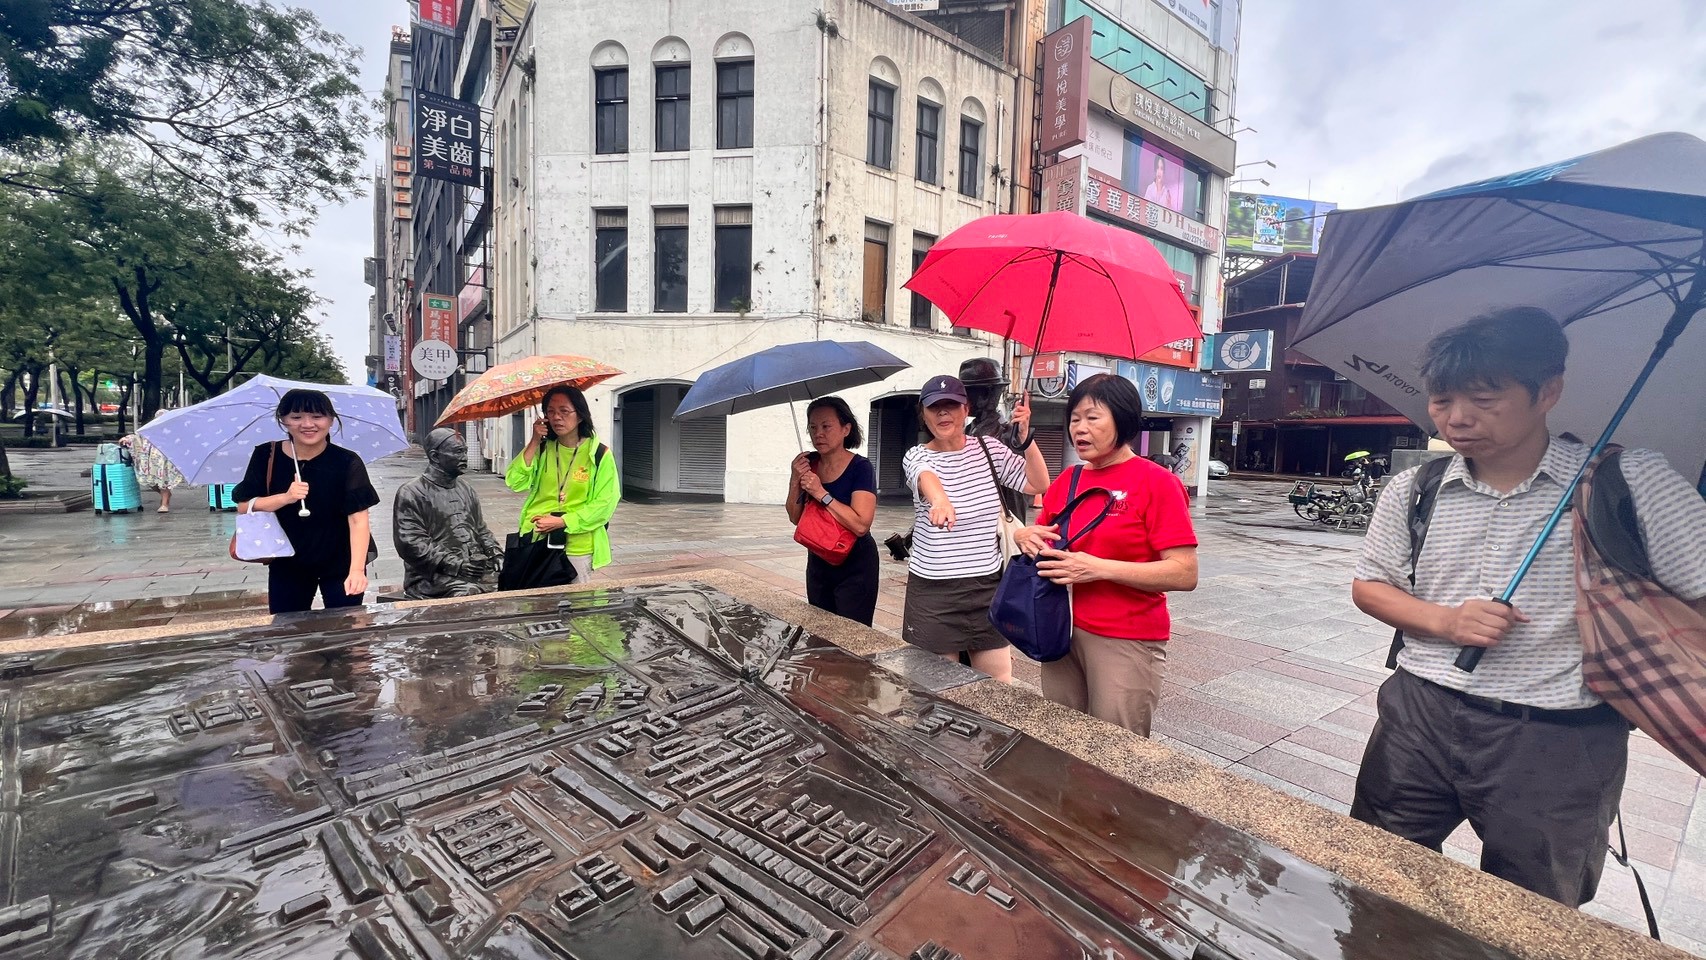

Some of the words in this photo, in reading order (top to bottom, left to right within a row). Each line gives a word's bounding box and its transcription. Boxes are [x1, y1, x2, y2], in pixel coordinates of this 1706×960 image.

[421, 105, 472, 139] 淨白
[421, 133, 474, 166] 美齒
[396, 146, 408, 217] HOTEL
[423, 158, 473, 178] 第一品牌
[419, 347, 450, 362] 美甲
